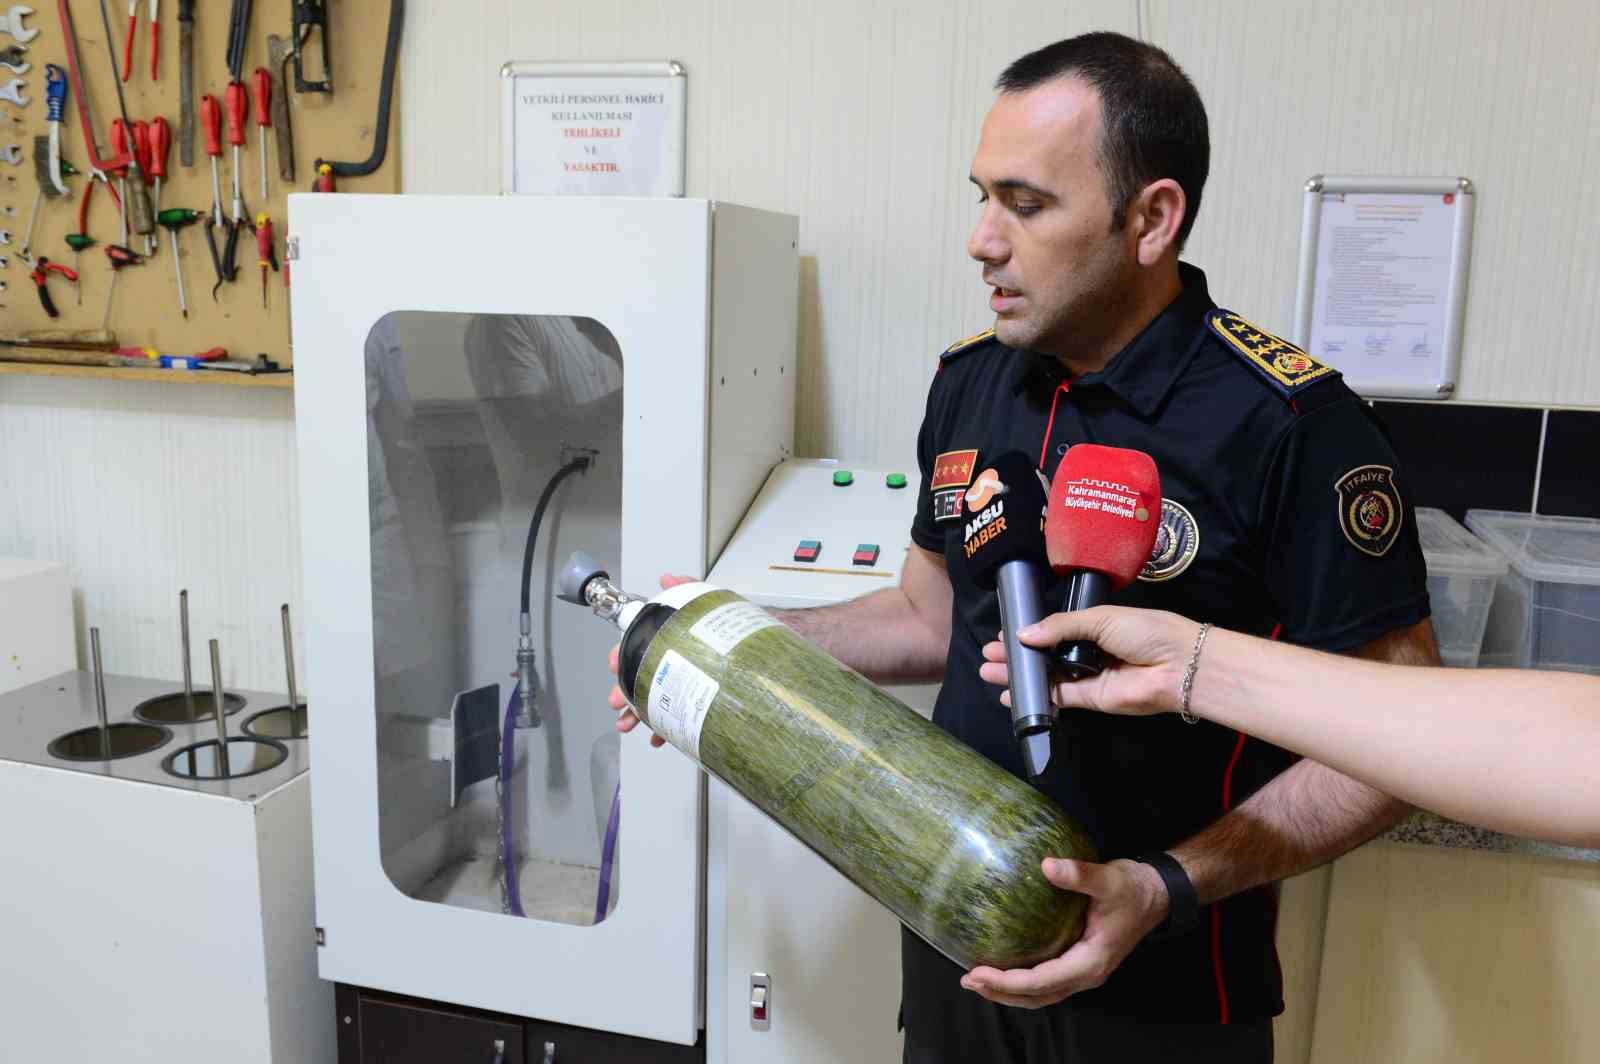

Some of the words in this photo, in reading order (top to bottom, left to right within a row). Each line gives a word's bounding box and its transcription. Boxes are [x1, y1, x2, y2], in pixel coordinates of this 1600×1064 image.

[568, 95, 623, 105] PERSONEL
[551, 111, 633, 121] KULLANILMASI
[964, 499, 1004, 543] AKSU
[963, 516, 1008, 558] HABER
